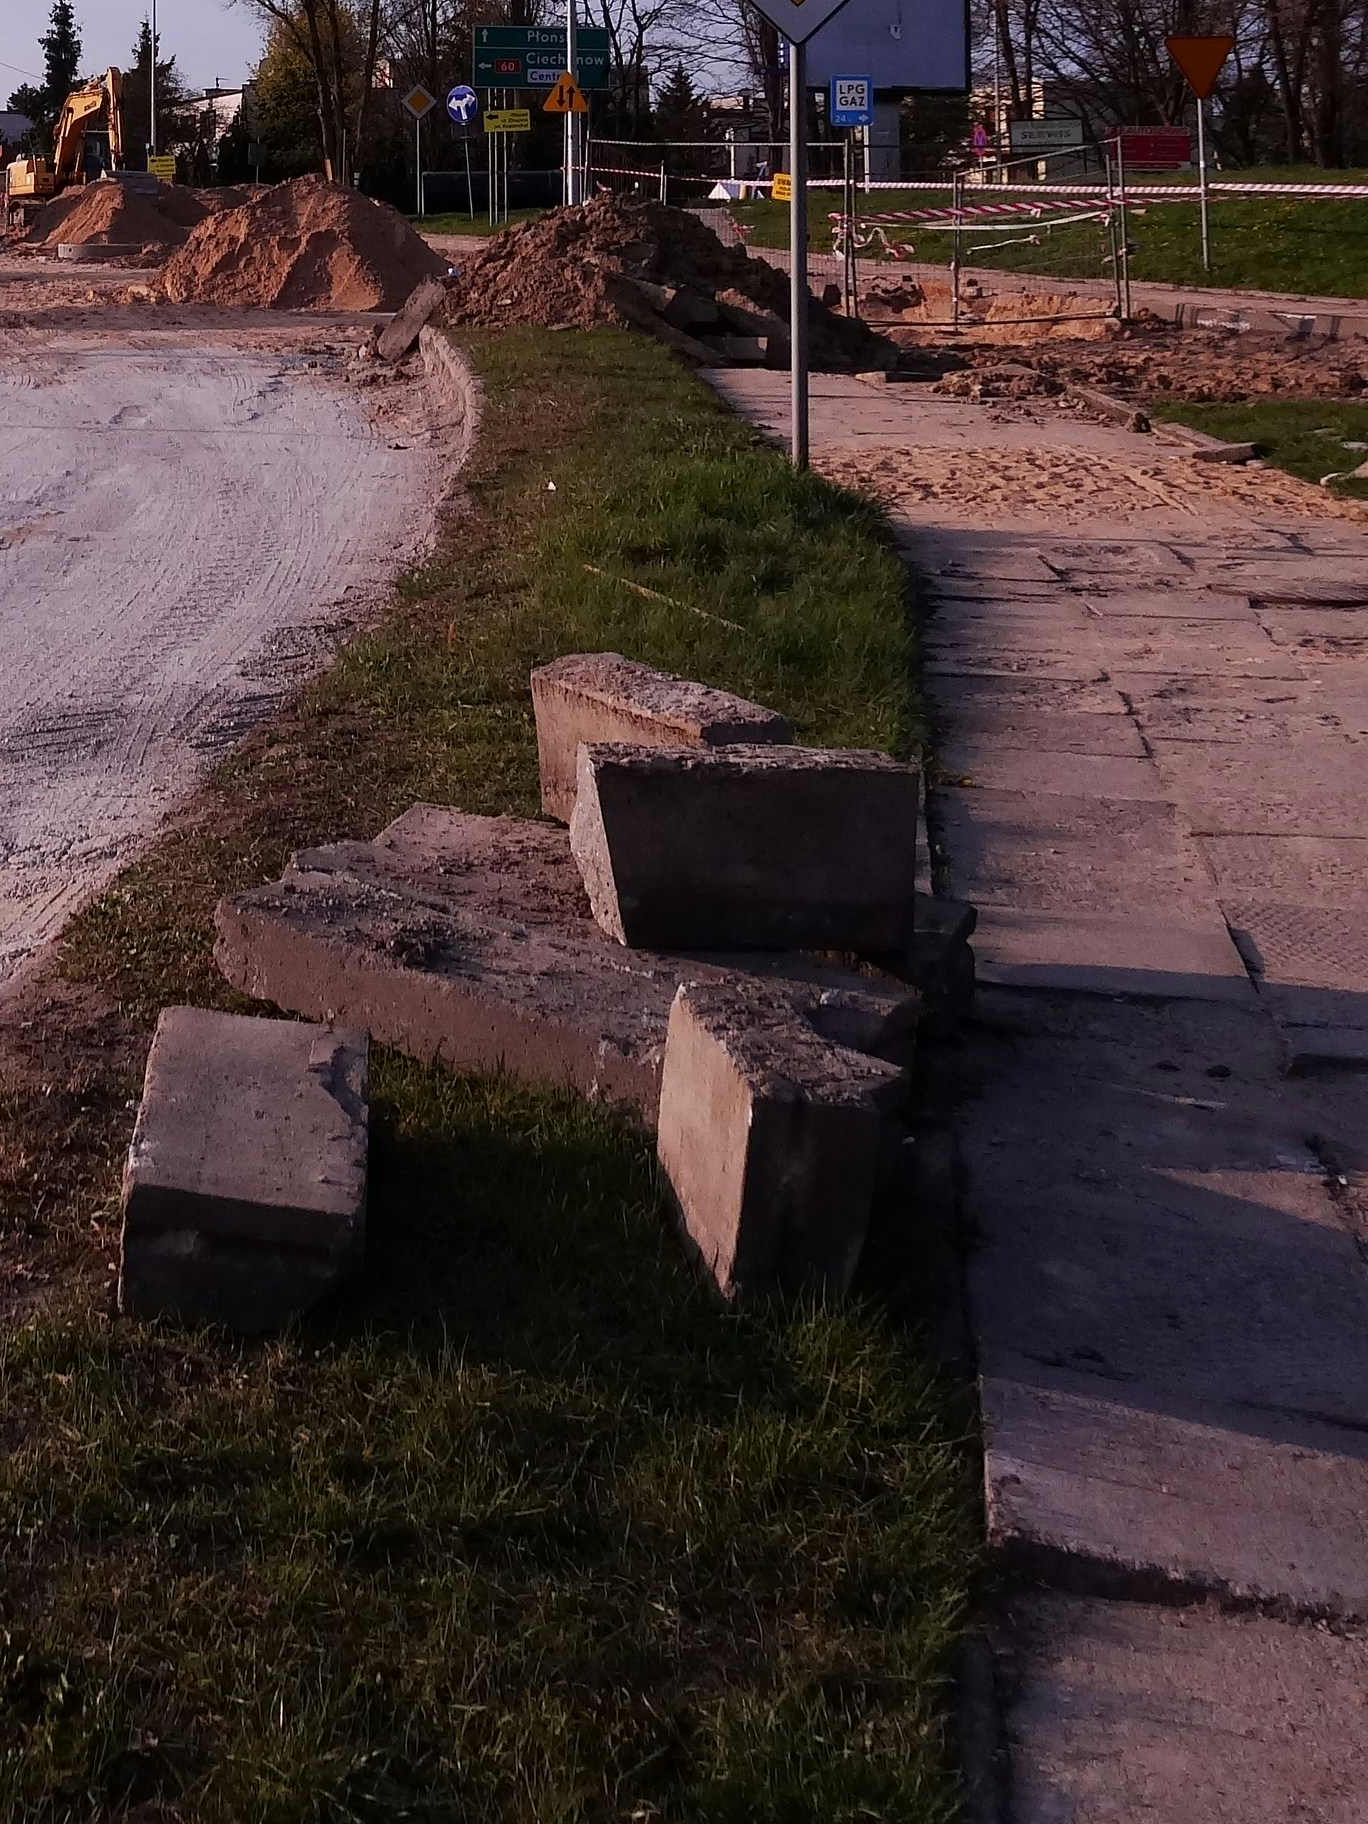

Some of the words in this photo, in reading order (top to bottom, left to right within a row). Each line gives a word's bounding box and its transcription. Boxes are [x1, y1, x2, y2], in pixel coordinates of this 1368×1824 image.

[501, 61, 515, 71] 60
[526, 52, 605, 65] Ciechnów
[839, 84, 865, 94] LPG
[839, 96, 865, 106] GAZ
